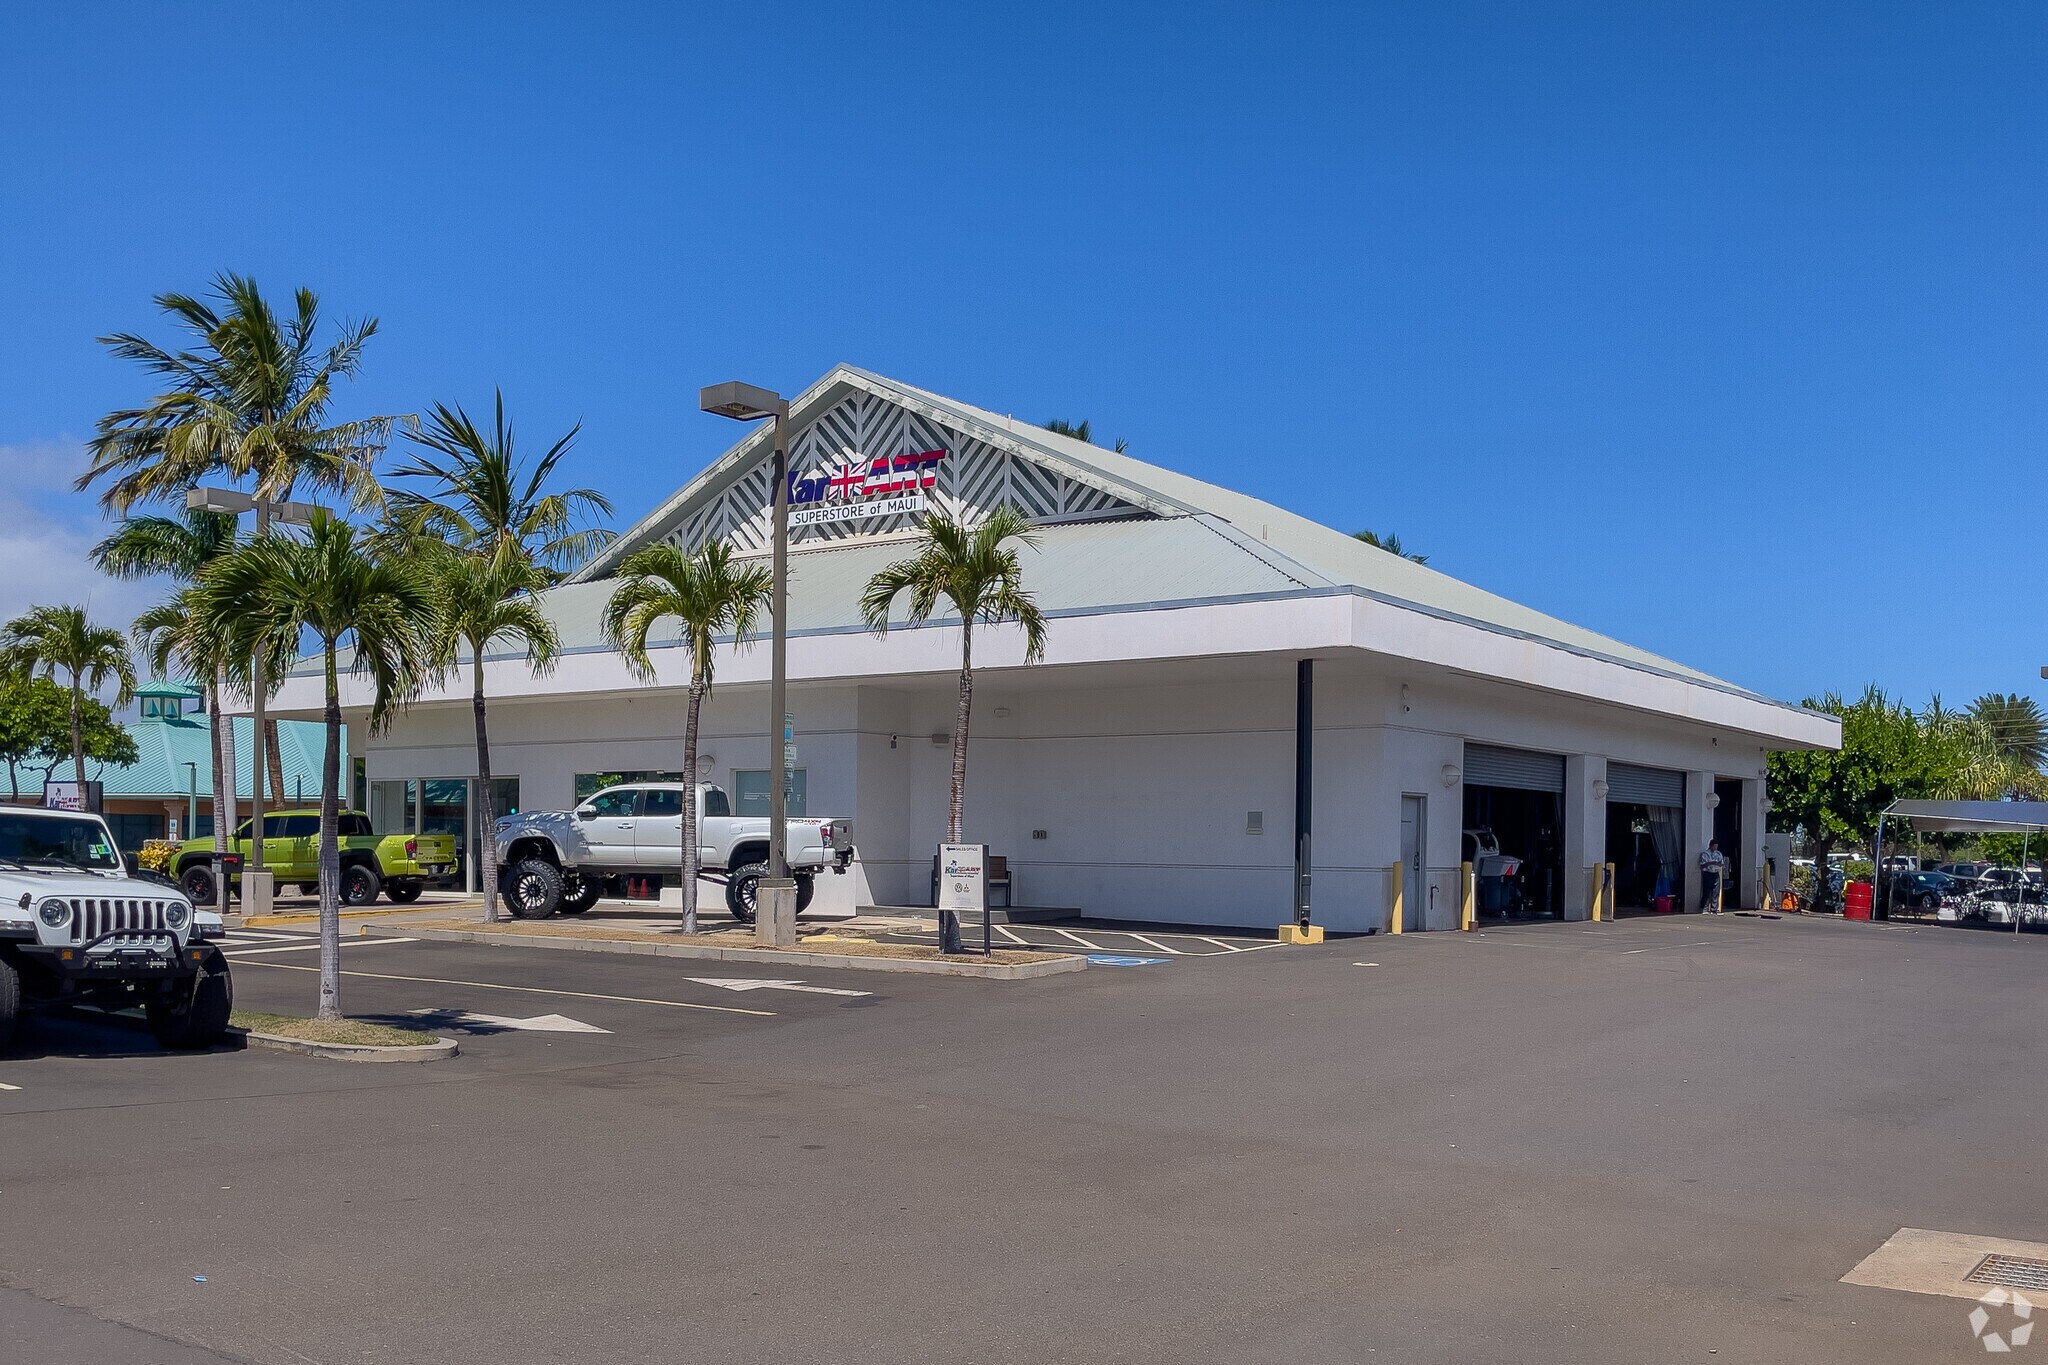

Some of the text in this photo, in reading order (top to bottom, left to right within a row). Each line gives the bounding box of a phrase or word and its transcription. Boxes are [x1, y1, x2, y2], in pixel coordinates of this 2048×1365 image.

[794, 495, 917, 525] SUPERSTORE of MAUI
